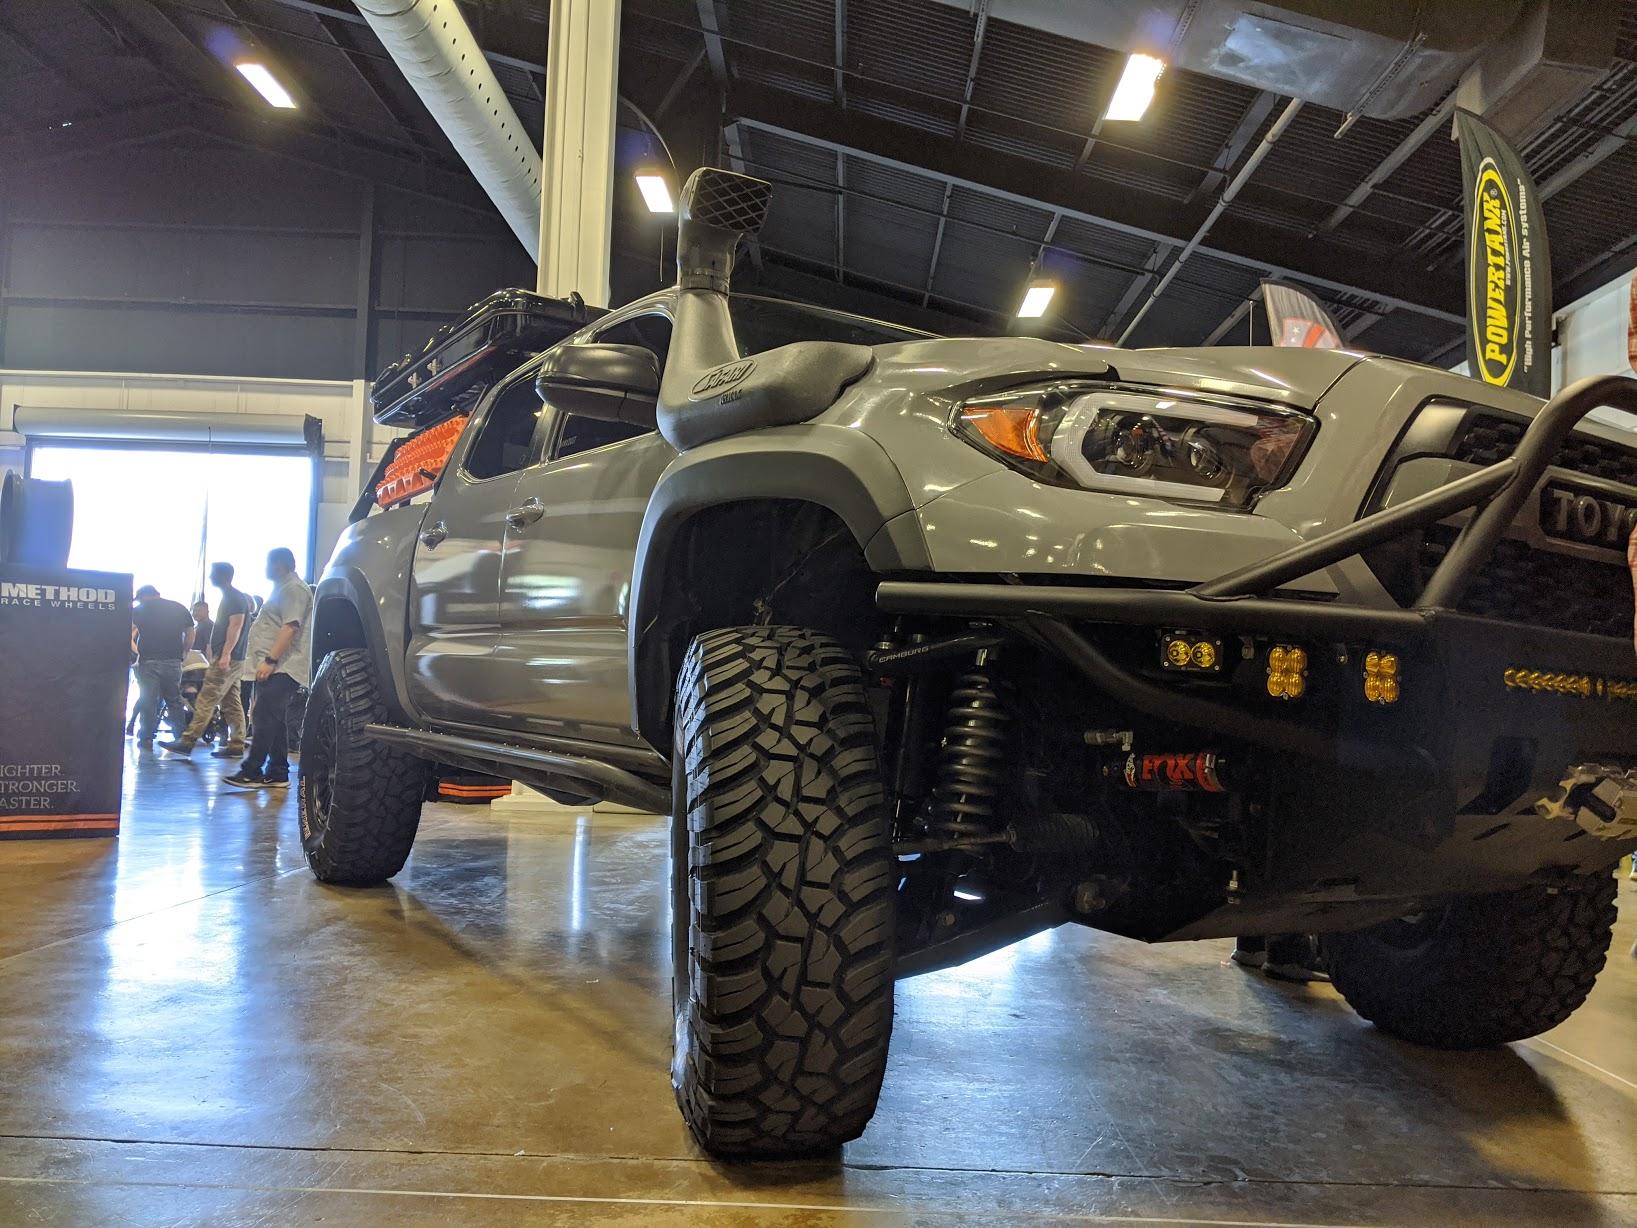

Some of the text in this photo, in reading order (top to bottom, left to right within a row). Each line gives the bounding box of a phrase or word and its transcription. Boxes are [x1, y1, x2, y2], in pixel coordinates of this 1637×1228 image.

[1522, 238, 1530, 258] Air
[1483, 191, 1509, 366] POWERTANK
[1524, 260, 1533, 338] Performance
[1552, 488, 1637, 542] TOY
[0, 597, 115, 610] RACE WHEELS
[1, 582, 116, 603] METHOD
[879, 645, 929, 663] CAMBURG
[1142, 753, 1195, 781] FOX
